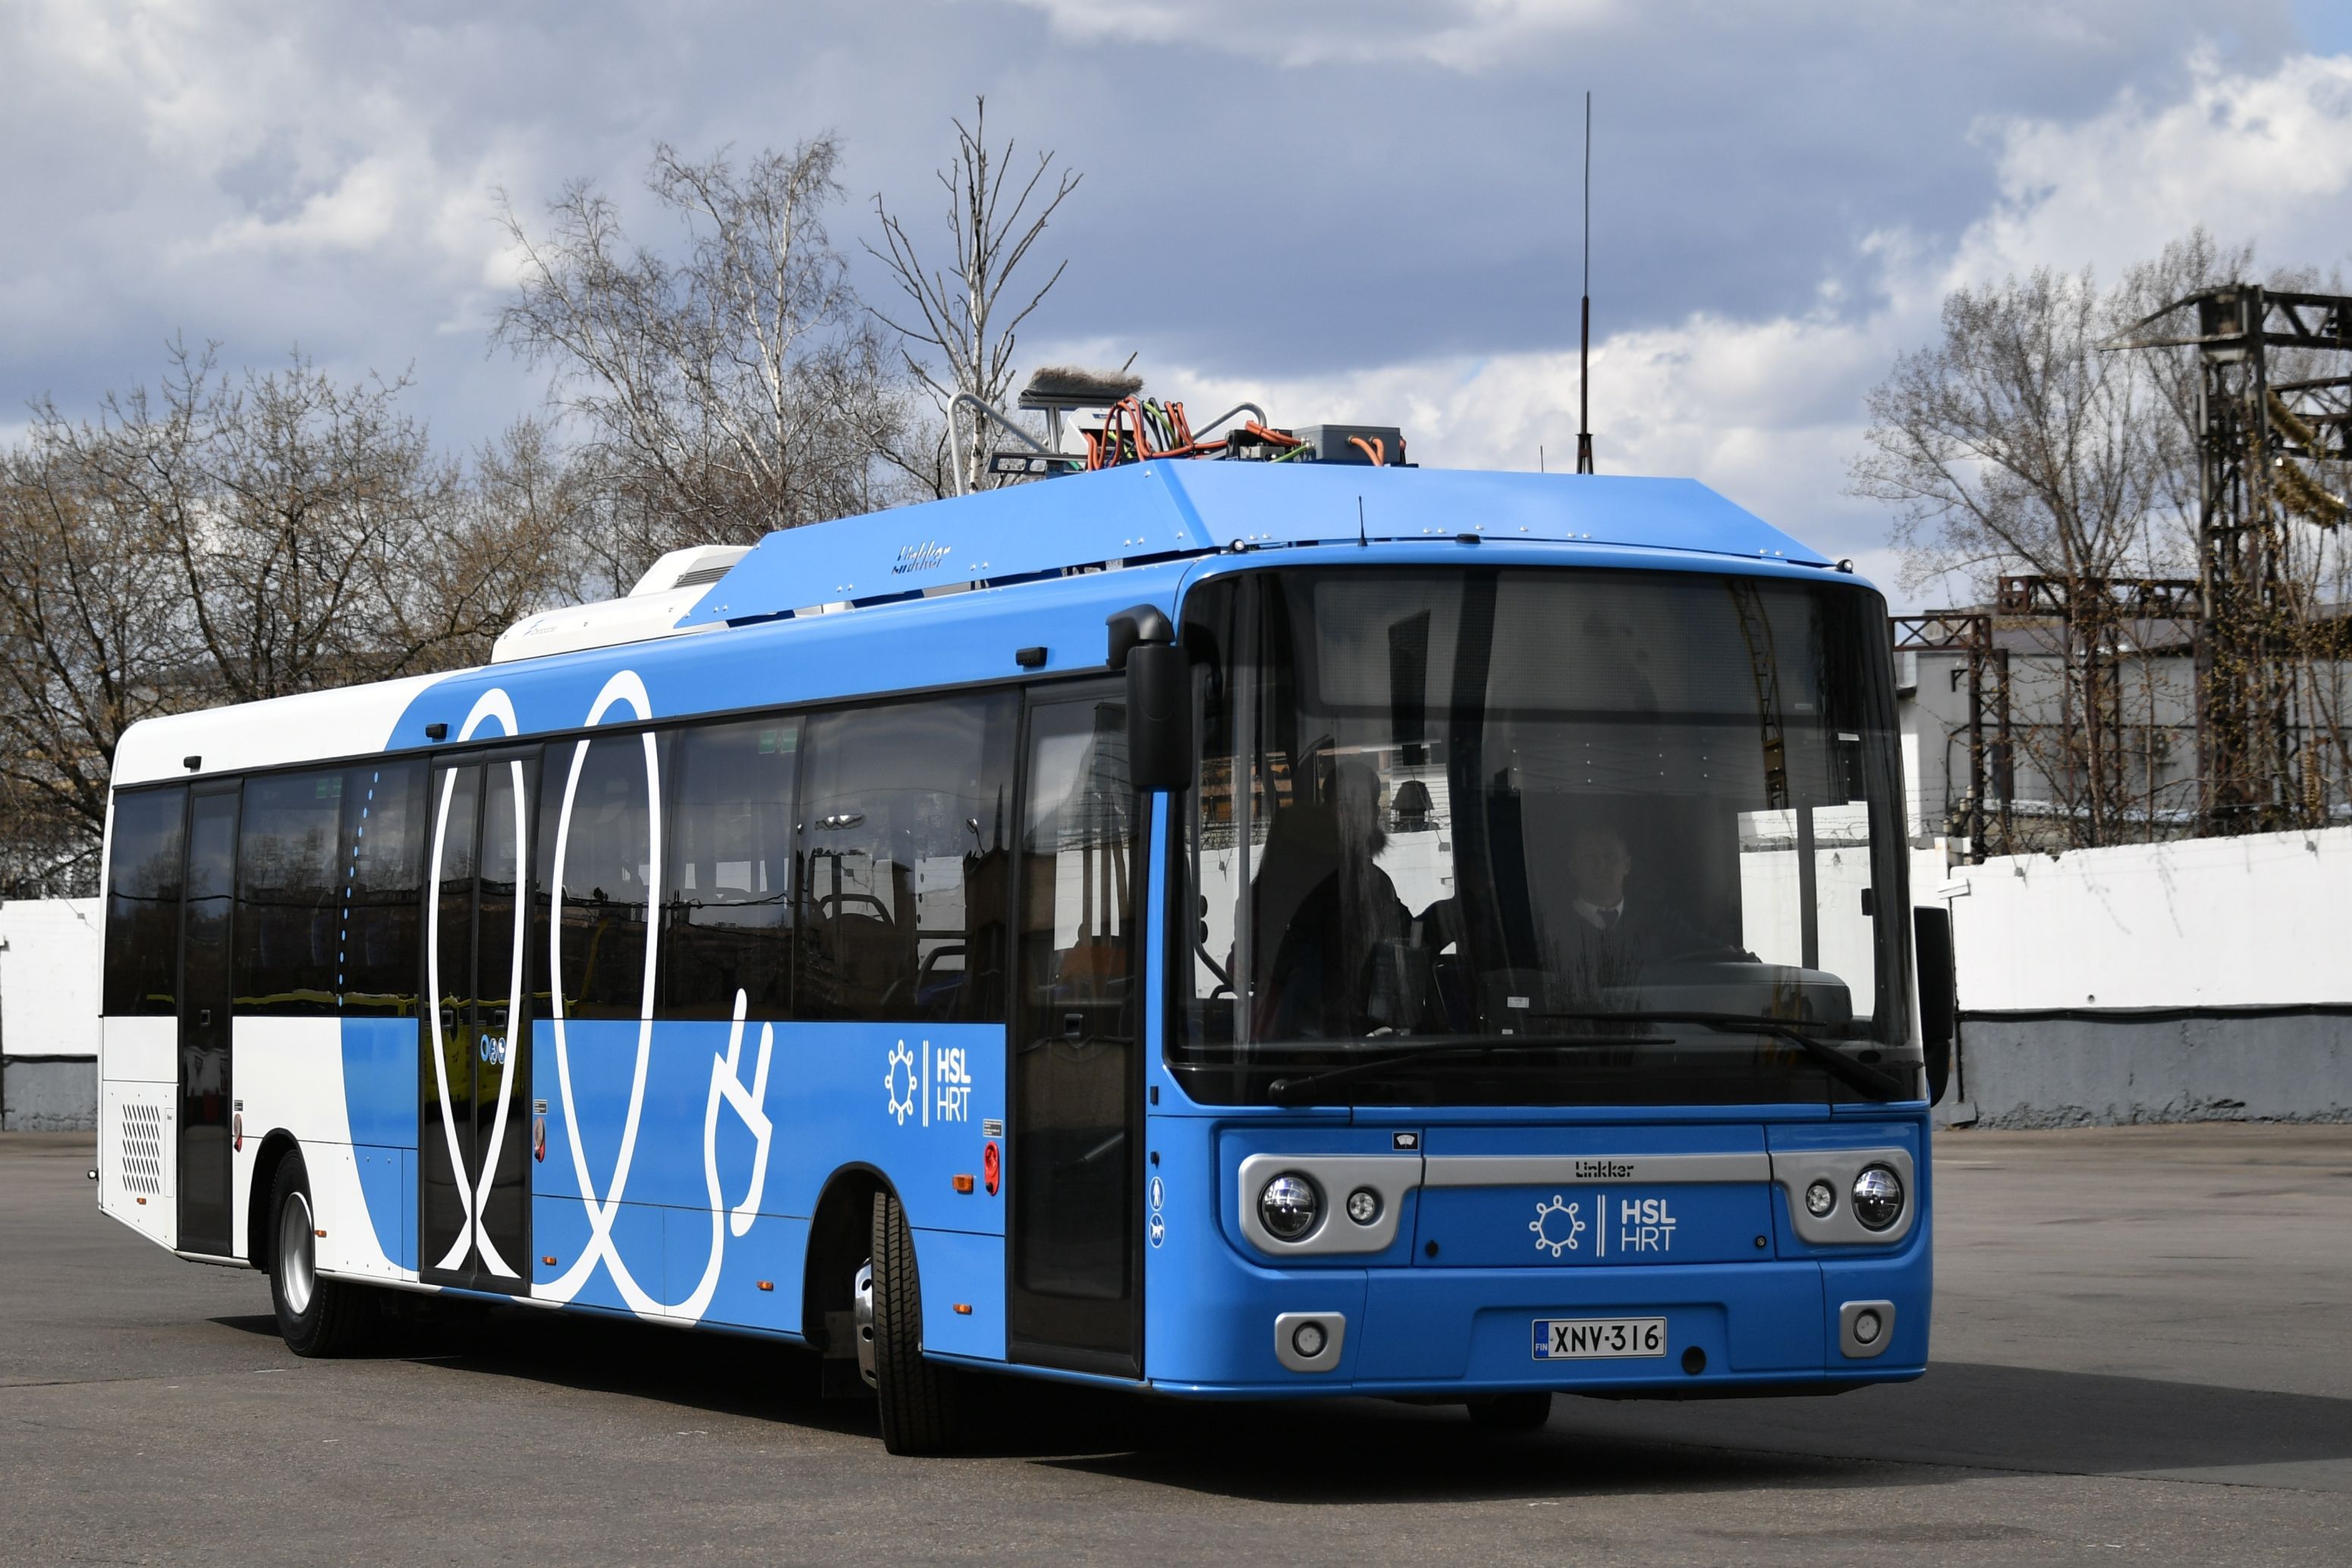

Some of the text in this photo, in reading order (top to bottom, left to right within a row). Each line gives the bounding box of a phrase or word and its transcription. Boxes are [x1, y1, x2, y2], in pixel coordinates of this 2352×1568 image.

[937, 1048, 971, 1084] HSL
[937, 1086, 971, 1123] HRT
[1576, 1161, 1634, 1178] Linkker
[1621, 1199, 1676, 1224] HSL
[1621, 1226, 1676, 1252] HRT
[1535, 1343, 1548, 1351] FIN
